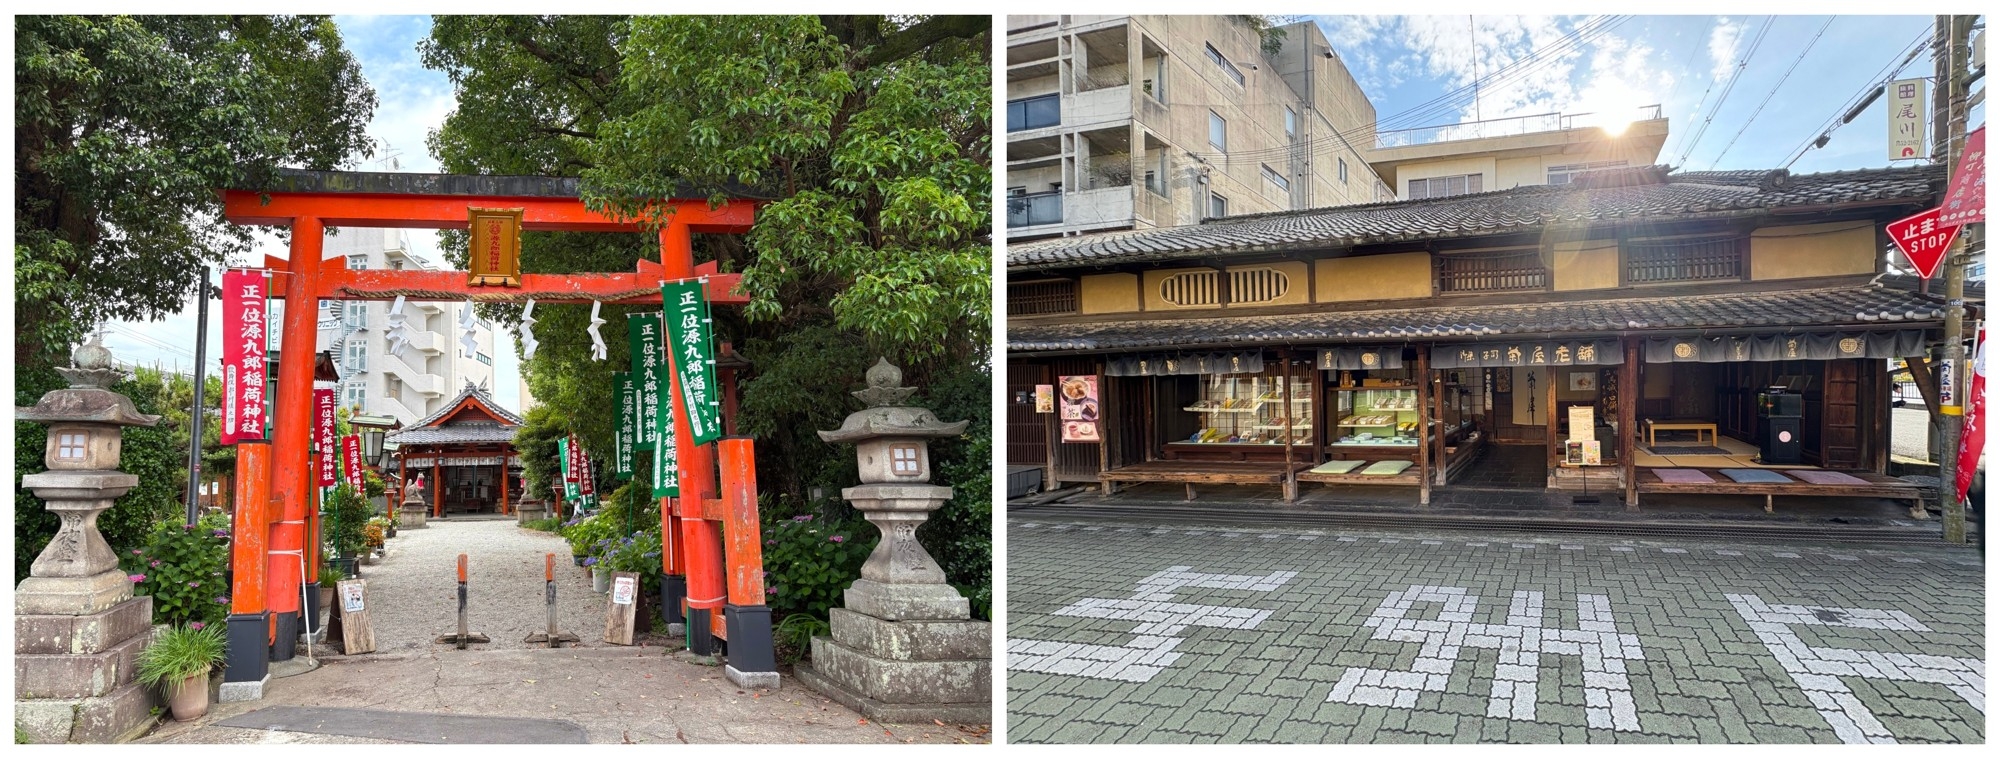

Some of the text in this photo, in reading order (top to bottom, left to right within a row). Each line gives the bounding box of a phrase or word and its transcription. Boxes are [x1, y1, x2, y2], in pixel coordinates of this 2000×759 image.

[1896, 103, 1917, 138] 尾川
[1902, 218, 1941, 240] 止ま
[1911, 233, 1947, 253] STOP
[240, 285, 262, 435] 正一位源九郎稲荷神社
[641, 323, 658, 443] 正一位源九郎稲荷神社
[679, 290, 716, 433] 正一位源九郎稲荷
[1507, 345, 1595, 365] 菊屋老舗
[320, 395, 334, 481] 正一位源九郎稲荷神社
[622, 380, 634, 473] 正一位源九郎稲荷神社
